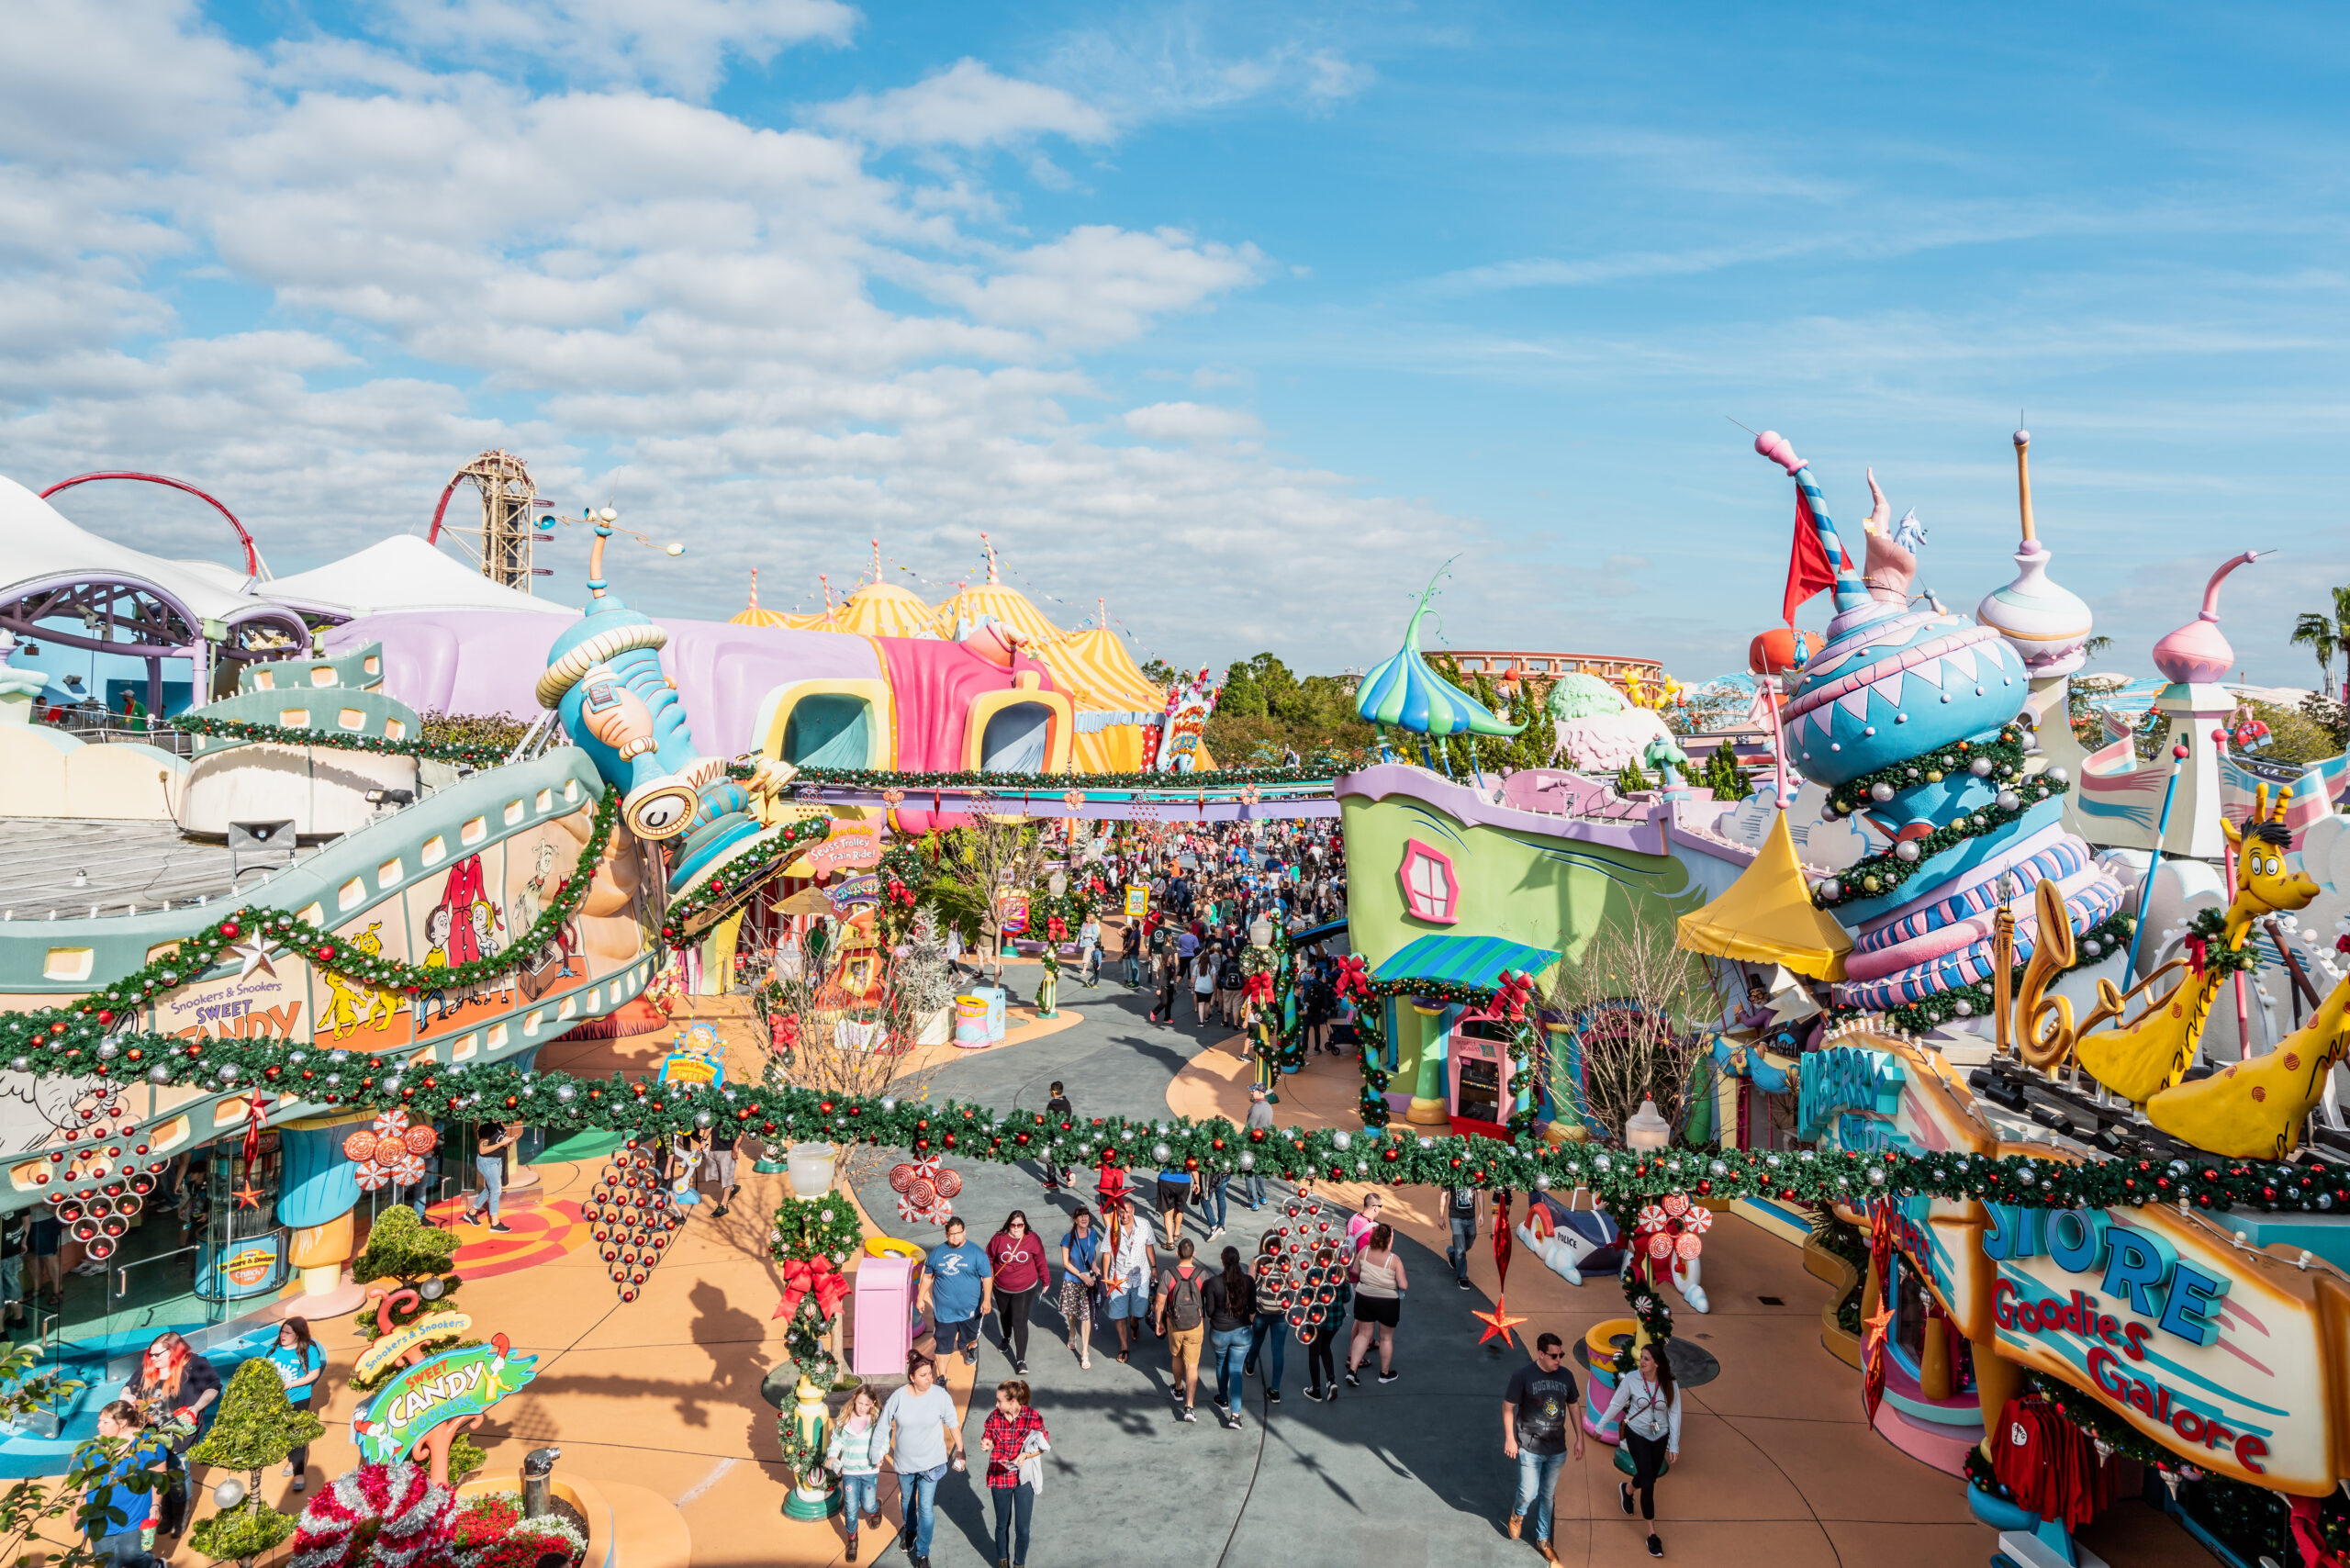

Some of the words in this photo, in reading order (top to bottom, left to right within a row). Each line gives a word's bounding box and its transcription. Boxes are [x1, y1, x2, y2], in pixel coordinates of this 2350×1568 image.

[847, 826, 859, 834] the
[860, 824, 874, 836] Sky
[811, 842, 839, 861] Seuss
[839, 837, 869, 848] Trolley
[828, 853, 851, 863] Train
[853, 849, 876, 860] Ride!
[171, 991, 224, 1015] Snookers
[226, 988, 234, 998] &
[237, 981, 282, 996] Snookers
[196, 1000, 252, 1024] SWEET
[677, 1070, 703, 1081] SWEET
[1557, 1232, 1577, 1249] POLICE
[1992, 1278, 2152, 1361] Goodies
[365, 1335, 408, 1371] Snookers
[408, 1331, 417, 1340] &
[419, 1318, 464, 1336] Snookers
[405, 1360, 449, 1389] SWEET
[1532, 1380, 1567, 1395] HOGWARTS
[386, 1360, 485, 1429] CANDY
[408, 1394, 476, 1438] COOKERS
[2087, 1347, 2271, 1474] Galore
